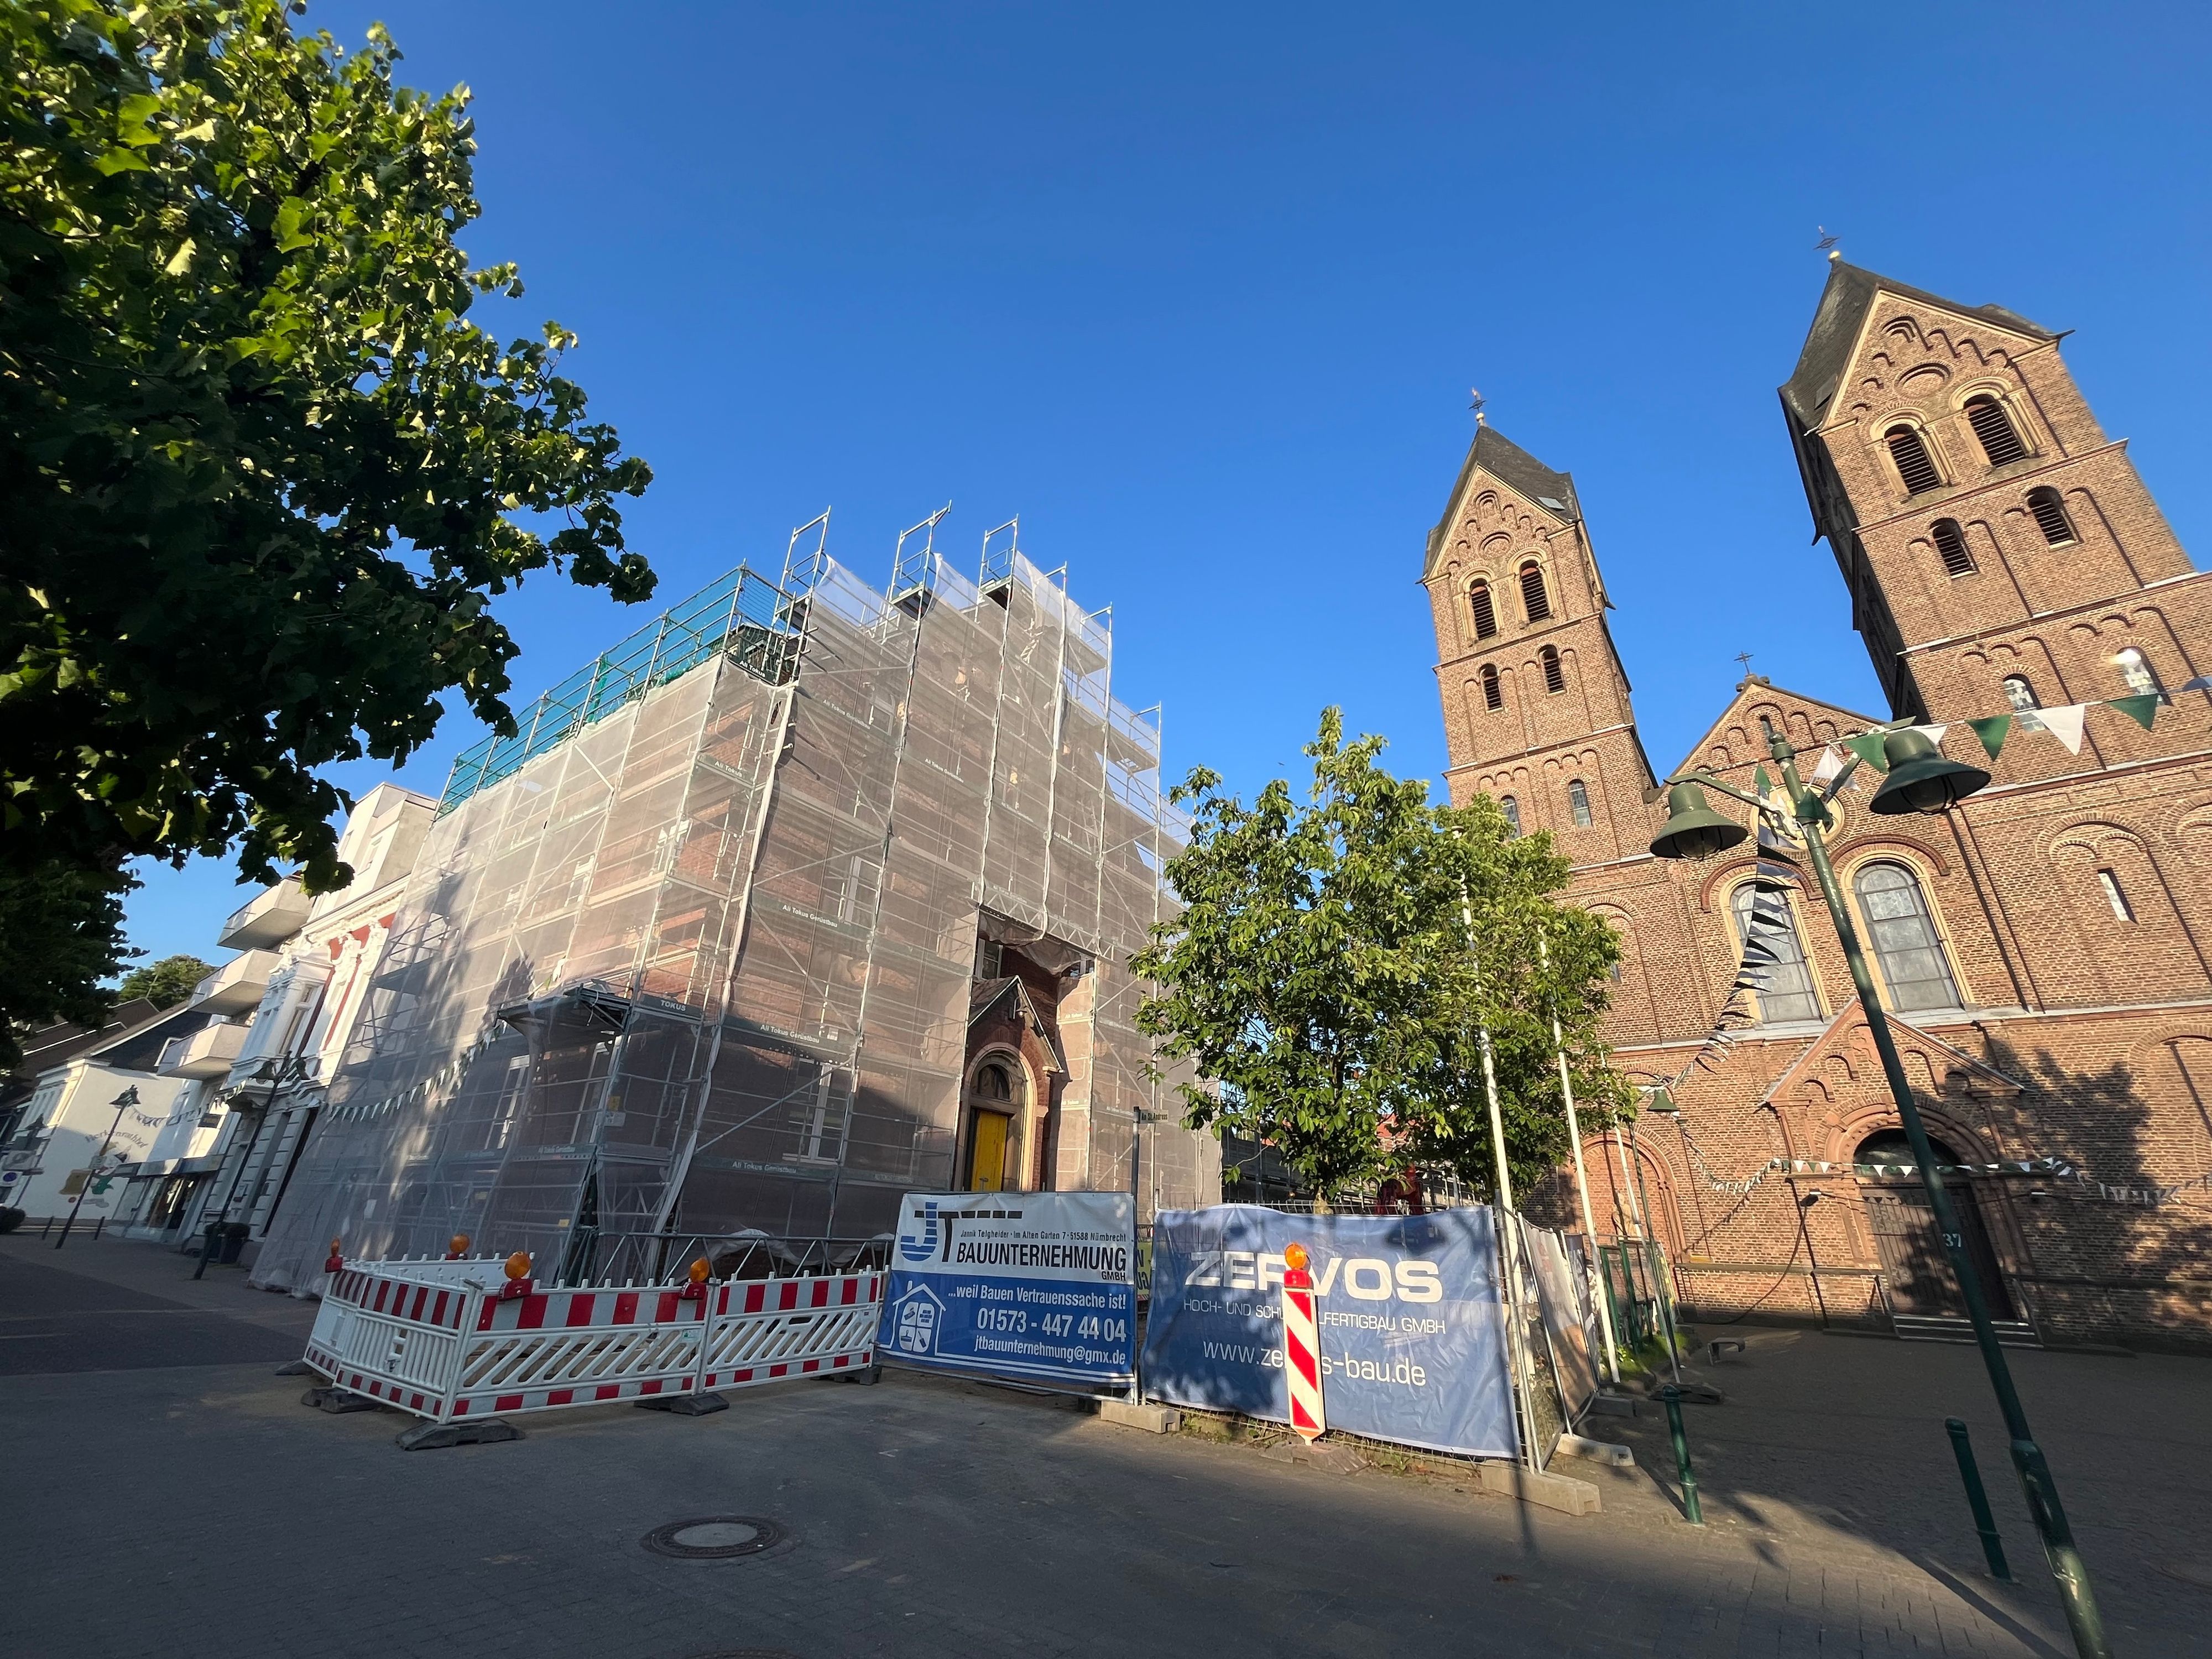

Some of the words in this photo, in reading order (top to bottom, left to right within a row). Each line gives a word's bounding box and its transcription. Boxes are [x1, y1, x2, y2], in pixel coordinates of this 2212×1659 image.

[749, 664, 766, 677] Tokus
[725, 764, 743, 778] Tokus
[792, 907, 808, 918] Tokus
[660, 999, 686, 1012] TOKUS
[770, 1026, 789, 1036] Tokus
[743, 1162, 763, 1171] Tokus
[978, 1230, 1009, 1239] Telgheider
[1022, 1230, 1039, 1239] Alten
[1040, 1231, 1060, 1239] Garten
[1062, 1232, 1066, 1240] 7
[1070, 1232, 1088, 1241] 51588
[1091, 1232, 1126, 1242] Nümbrecht
[1942, 1233, 1962, 1248] 37
[956, 1242, 1126, 1271] BAUUNTERNEHMUNG
[1102, 1271, 1126, 1281] GMBH
[980, 1285, 1014, 1301] Bauen
[1016, 1287, 1105, 1309] Vertrauenssache
[1108, 1293, 1126, 1310] ist!
[1184, 1298, 1222, 1313] HOCH-
[1225, 1302, 1251, 1316] UND
[1401, 1317, 1446, 1334] GMBH
[977, 1307, 1027, 1333] 01573
[1042, 1313, 1073, 1337] 447
[1078, 1316, 1099, 1340] 44
[1104, 1318, 1127, 1342] 04
[974, 1334, 1126, 1365] jtbauunternehmung@gmx.de
[1203, 1340, 1427, 1386] www.zes-bau.de
